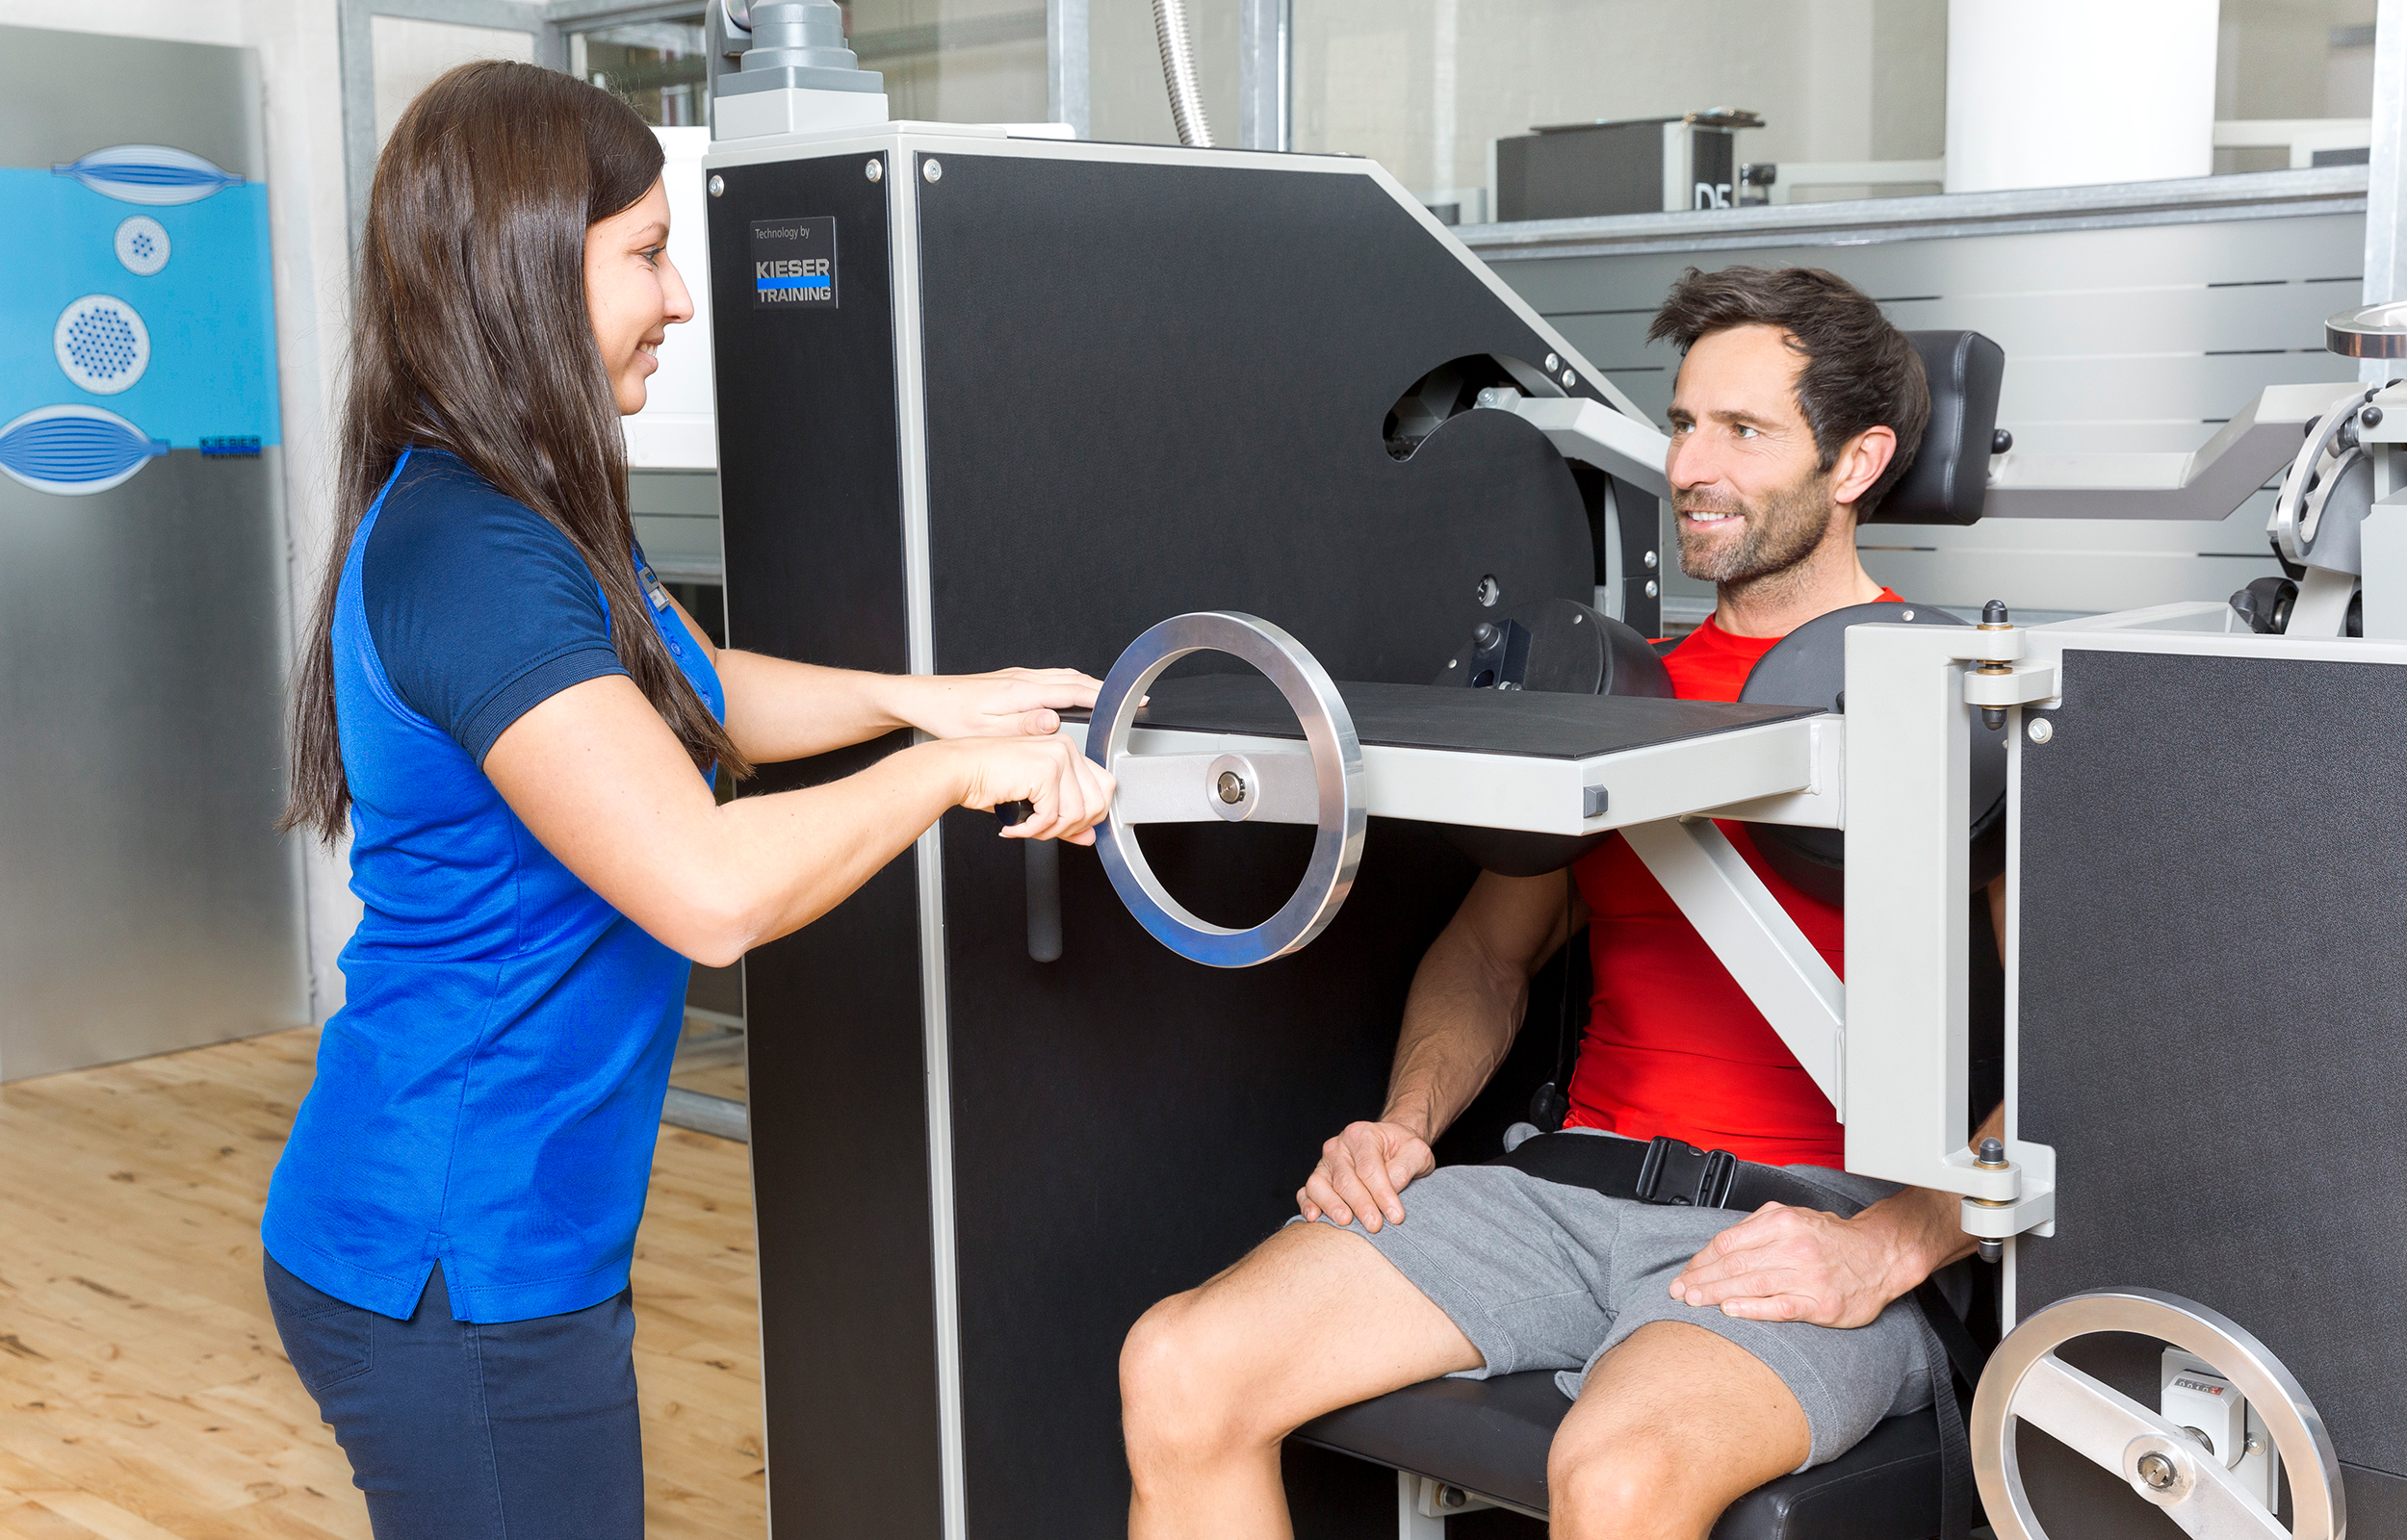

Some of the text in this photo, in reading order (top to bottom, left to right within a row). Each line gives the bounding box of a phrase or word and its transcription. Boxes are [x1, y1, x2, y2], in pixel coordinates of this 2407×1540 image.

[755, 225, 810, 240] Technology by
[756, 258, 830, 278] KIESER
[757, 287, 831, 303] TRAINING
